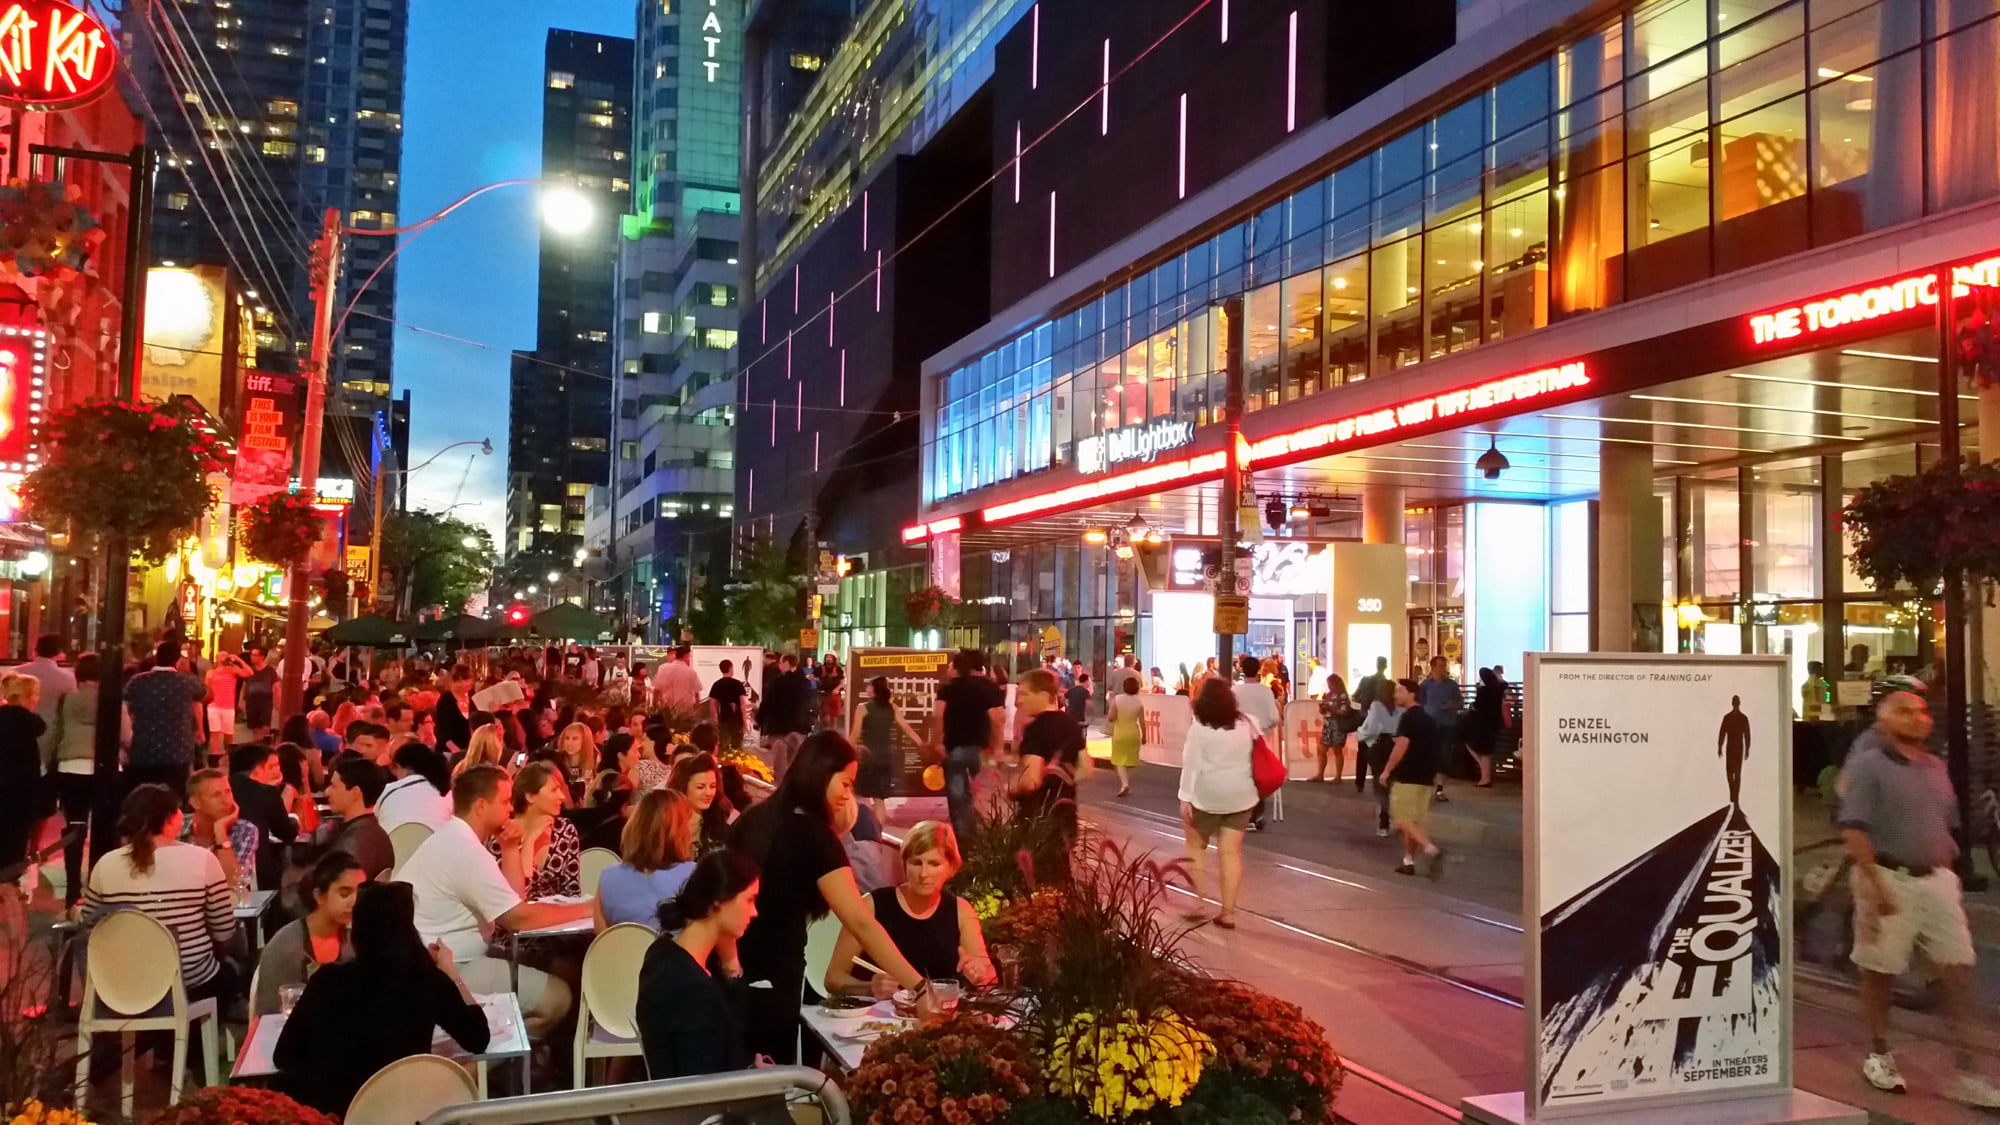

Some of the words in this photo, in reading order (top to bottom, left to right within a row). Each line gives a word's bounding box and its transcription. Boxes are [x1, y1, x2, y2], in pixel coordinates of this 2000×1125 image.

[1750, 307, 1802, 344] THE
[1803, 273, 1939, 331] TORONTO
[247, 375, 272, 392] tiff.
[254, 401, 271, 409] THIS
[259, 414, 279, 424] YOUR
[255, 425, 272, 434] FILM
[250, 436, 281, 448] FESTIVAL
[1132, 420, 1187, 462] Lightbox
[927, 654, 945, 662] STREET
[1649, 673, 1692, 682] TRAINING
[1694, 673, 1713, 682] DAY
[1559, 718, 1611, 729] DENZEL
[1559, 732, 1649, 743] WASHINGTON
[1643, 830, 1758, 1020] EQUALIZER
[1668, 927, 1693, 958] THE
[1712, 1059, 1722, 1068] IN
[1724, 1054, 1768, 1067] THEATERS
[1683, 1065, 1752, 1083] SEPTEMBER
[1754, 1063, 1768, 1075] 26
